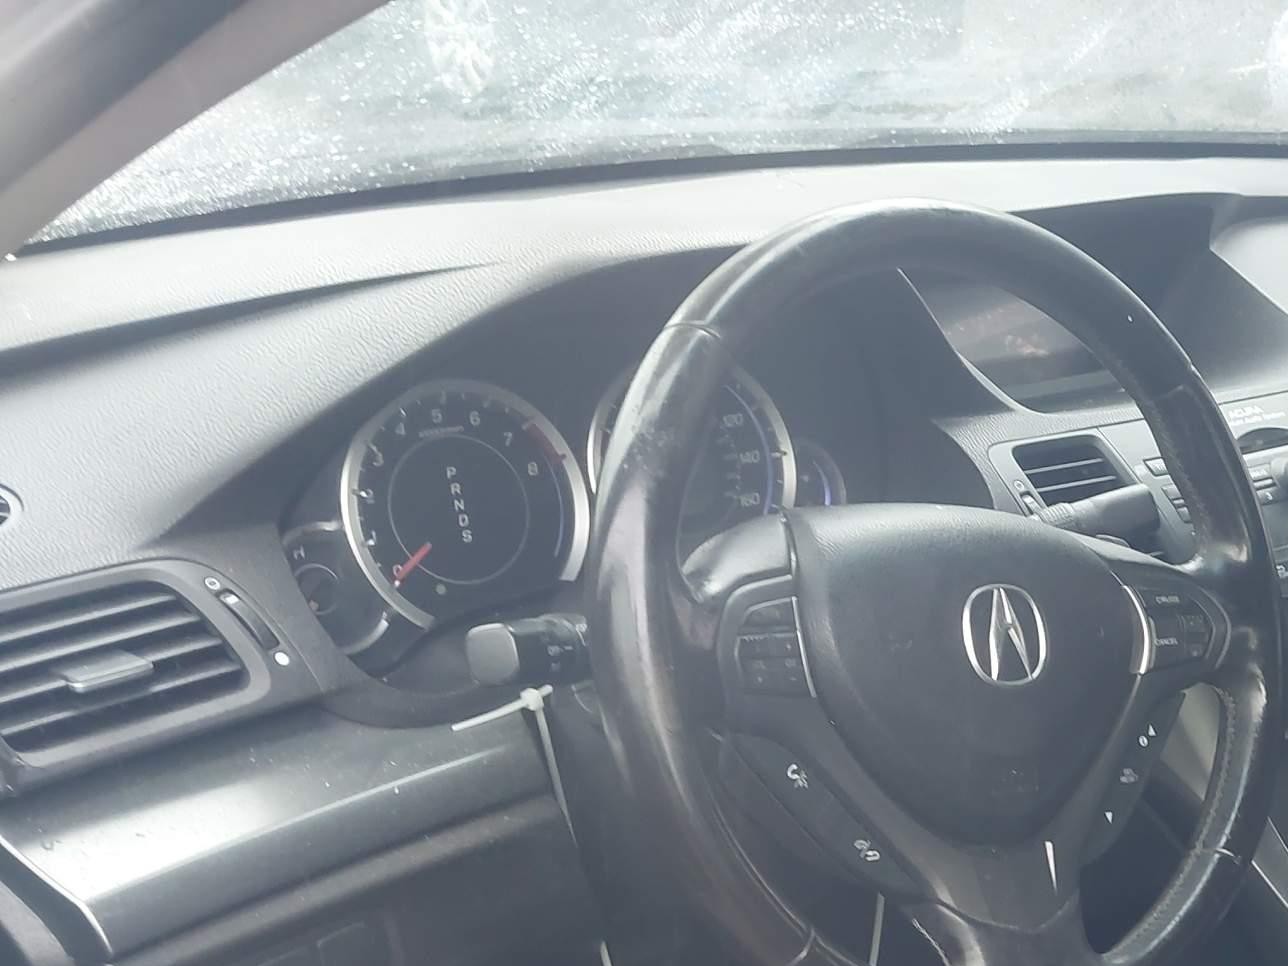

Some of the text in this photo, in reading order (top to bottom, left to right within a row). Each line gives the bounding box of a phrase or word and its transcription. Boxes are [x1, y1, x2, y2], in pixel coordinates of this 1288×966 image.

[431, 409, 443, 424] 5
[469, 411, 481, 426] 6
[503, 431, 514, 447] 7
[446, 466, 473, 543] P R N D S
